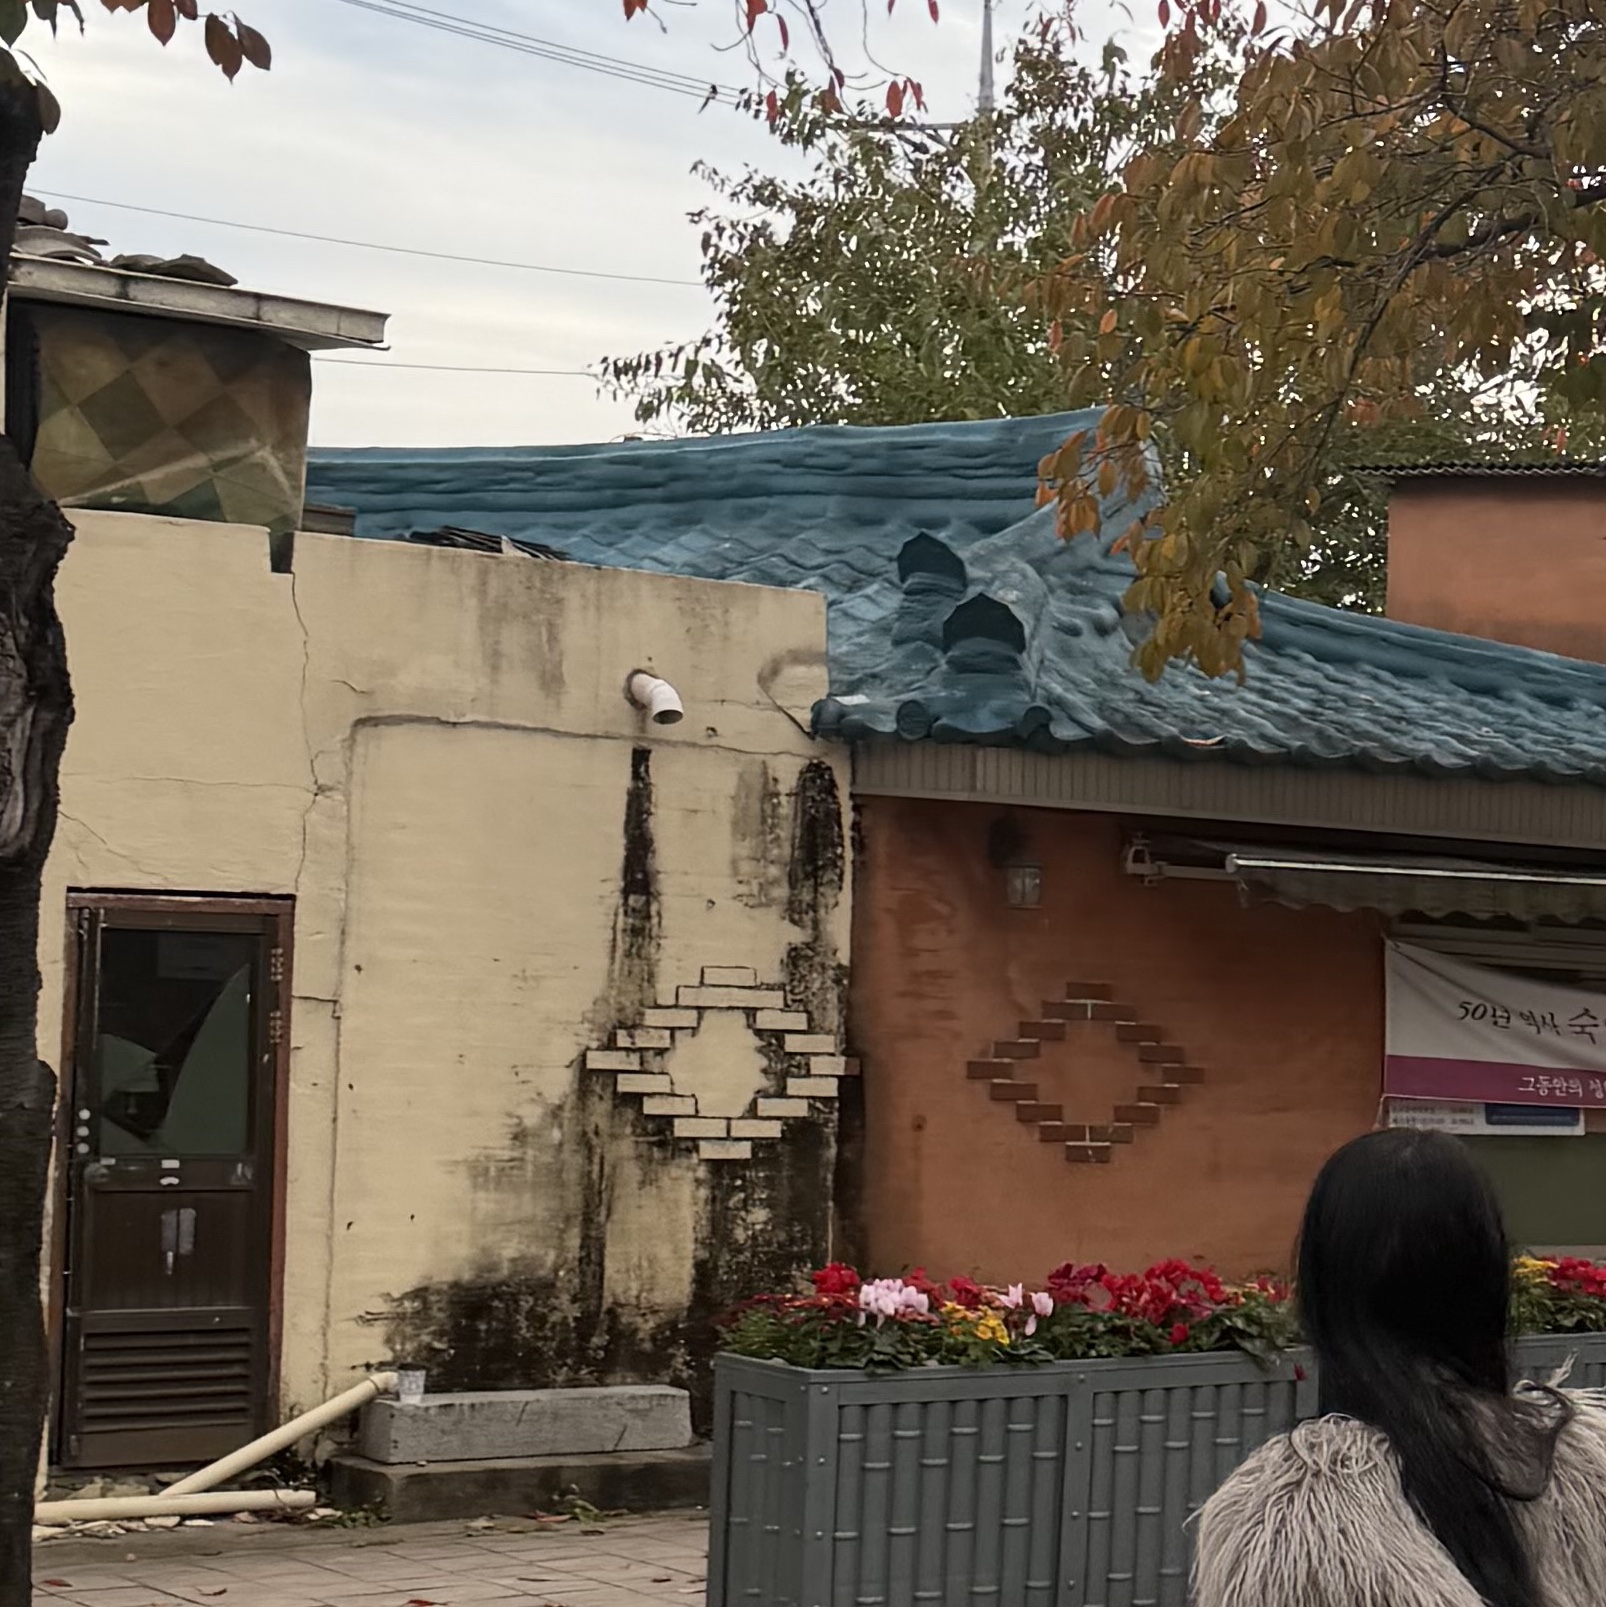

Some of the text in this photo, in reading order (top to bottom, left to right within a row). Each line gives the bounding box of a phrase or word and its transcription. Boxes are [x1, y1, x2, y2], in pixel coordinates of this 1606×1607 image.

[1456, 1000, 1512, 1030] 50년
[1518, 1011, 1561, 1037] 역사
[1517, 1075, 1584, 1099] 그동안의
